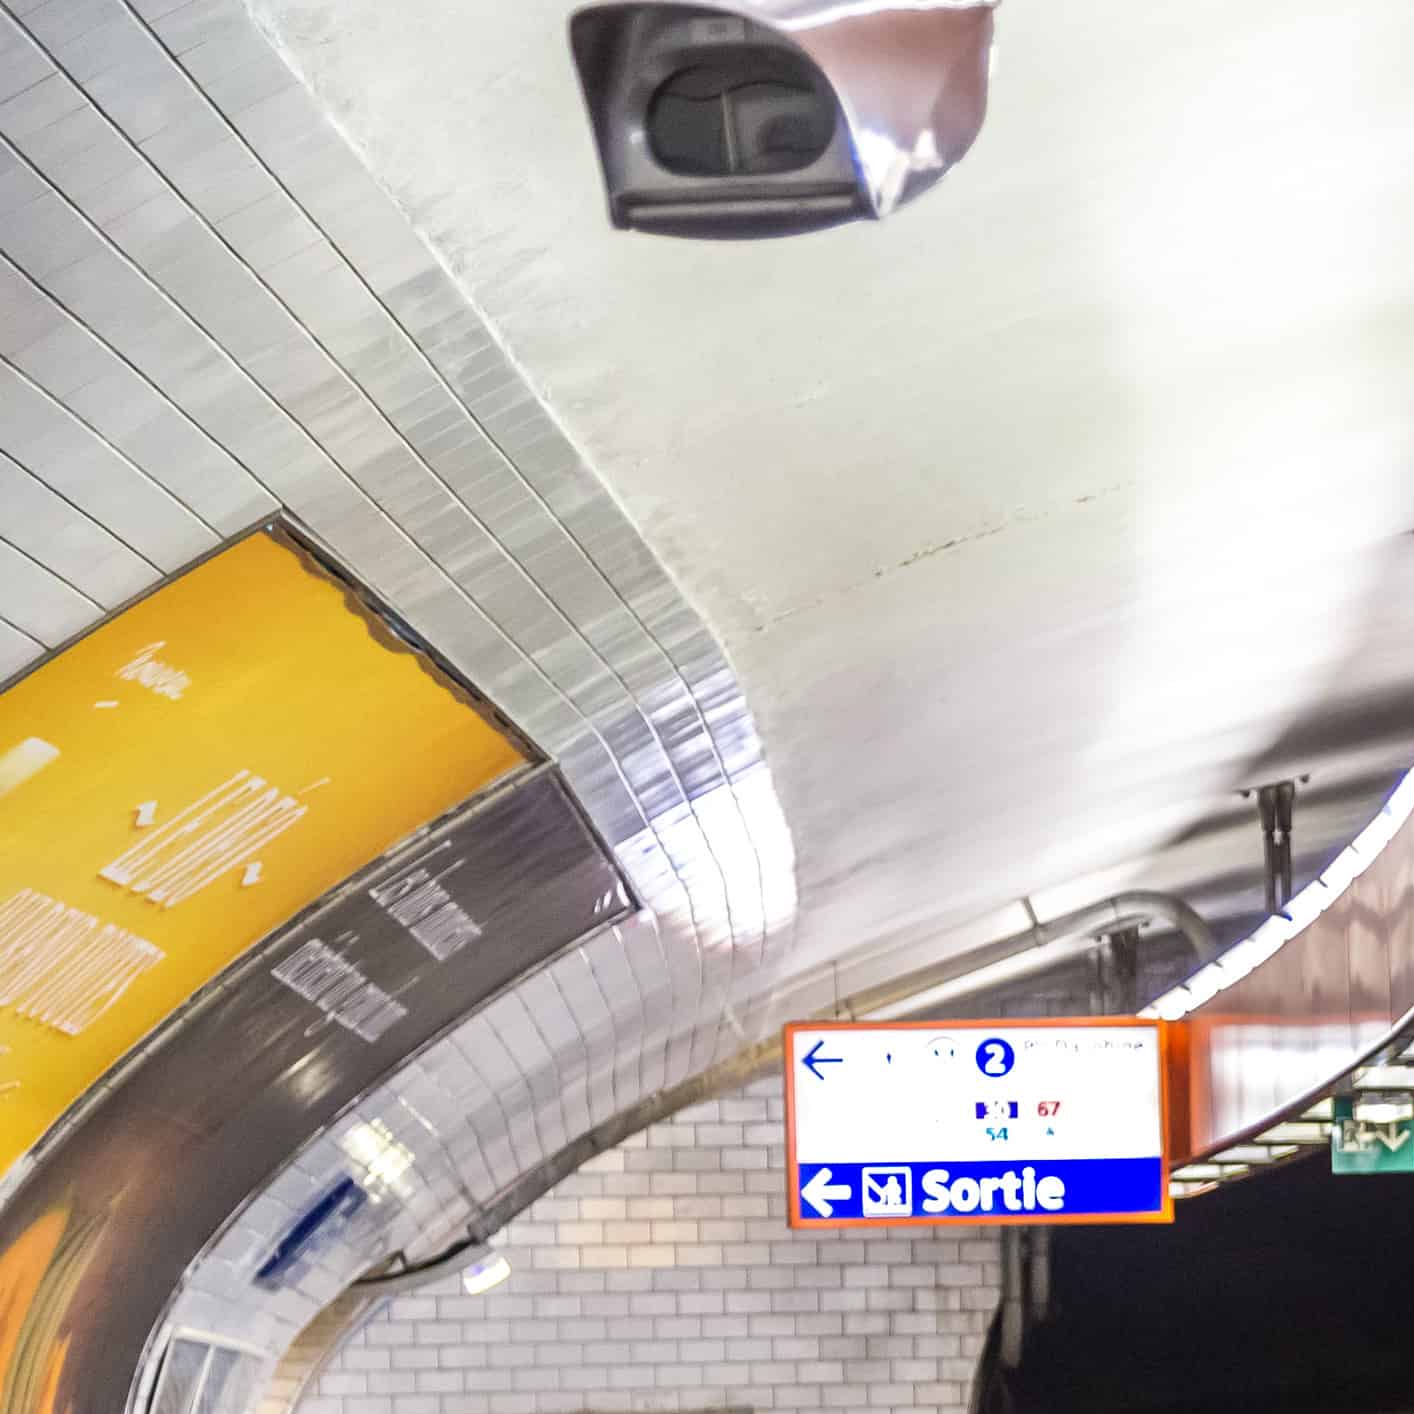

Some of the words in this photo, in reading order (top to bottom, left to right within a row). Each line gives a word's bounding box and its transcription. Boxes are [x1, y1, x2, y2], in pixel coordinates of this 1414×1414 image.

[984, 1043, 1006, 1075] 2
[1037, 1101, 1060, 1117] 67
[921, 1166, 1065, 1213] Sortie
